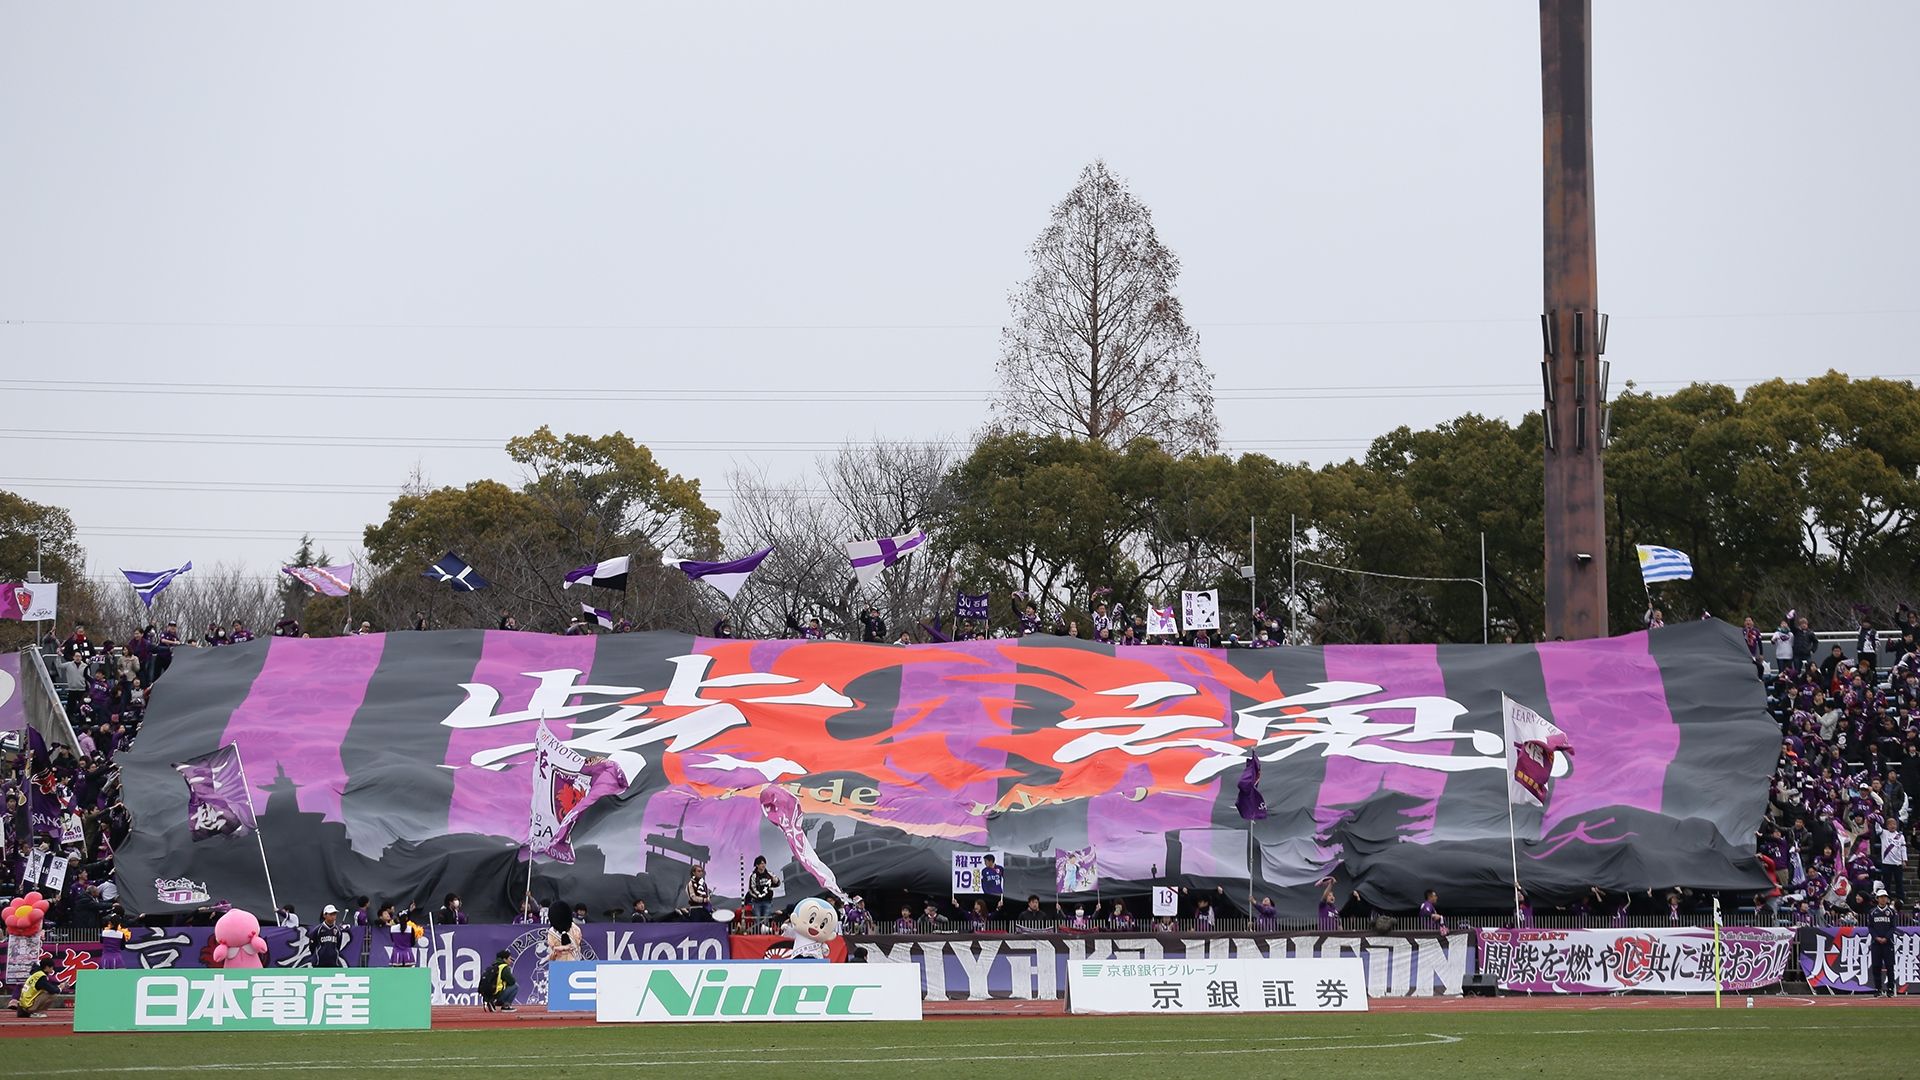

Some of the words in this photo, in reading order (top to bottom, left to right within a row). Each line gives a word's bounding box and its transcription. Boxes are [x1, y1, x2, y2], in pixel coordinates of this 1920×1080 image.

[955, 855, 982, 867] 耀平
[955, 871, 972, 888] 19
[1160, 890, 1172, 904] 13
[1106, 964, 1218, 977] 京都銀行グループ
[135, 973, 370, 1025] 日本電産
[636, 969, 882, 1017] Nidec
